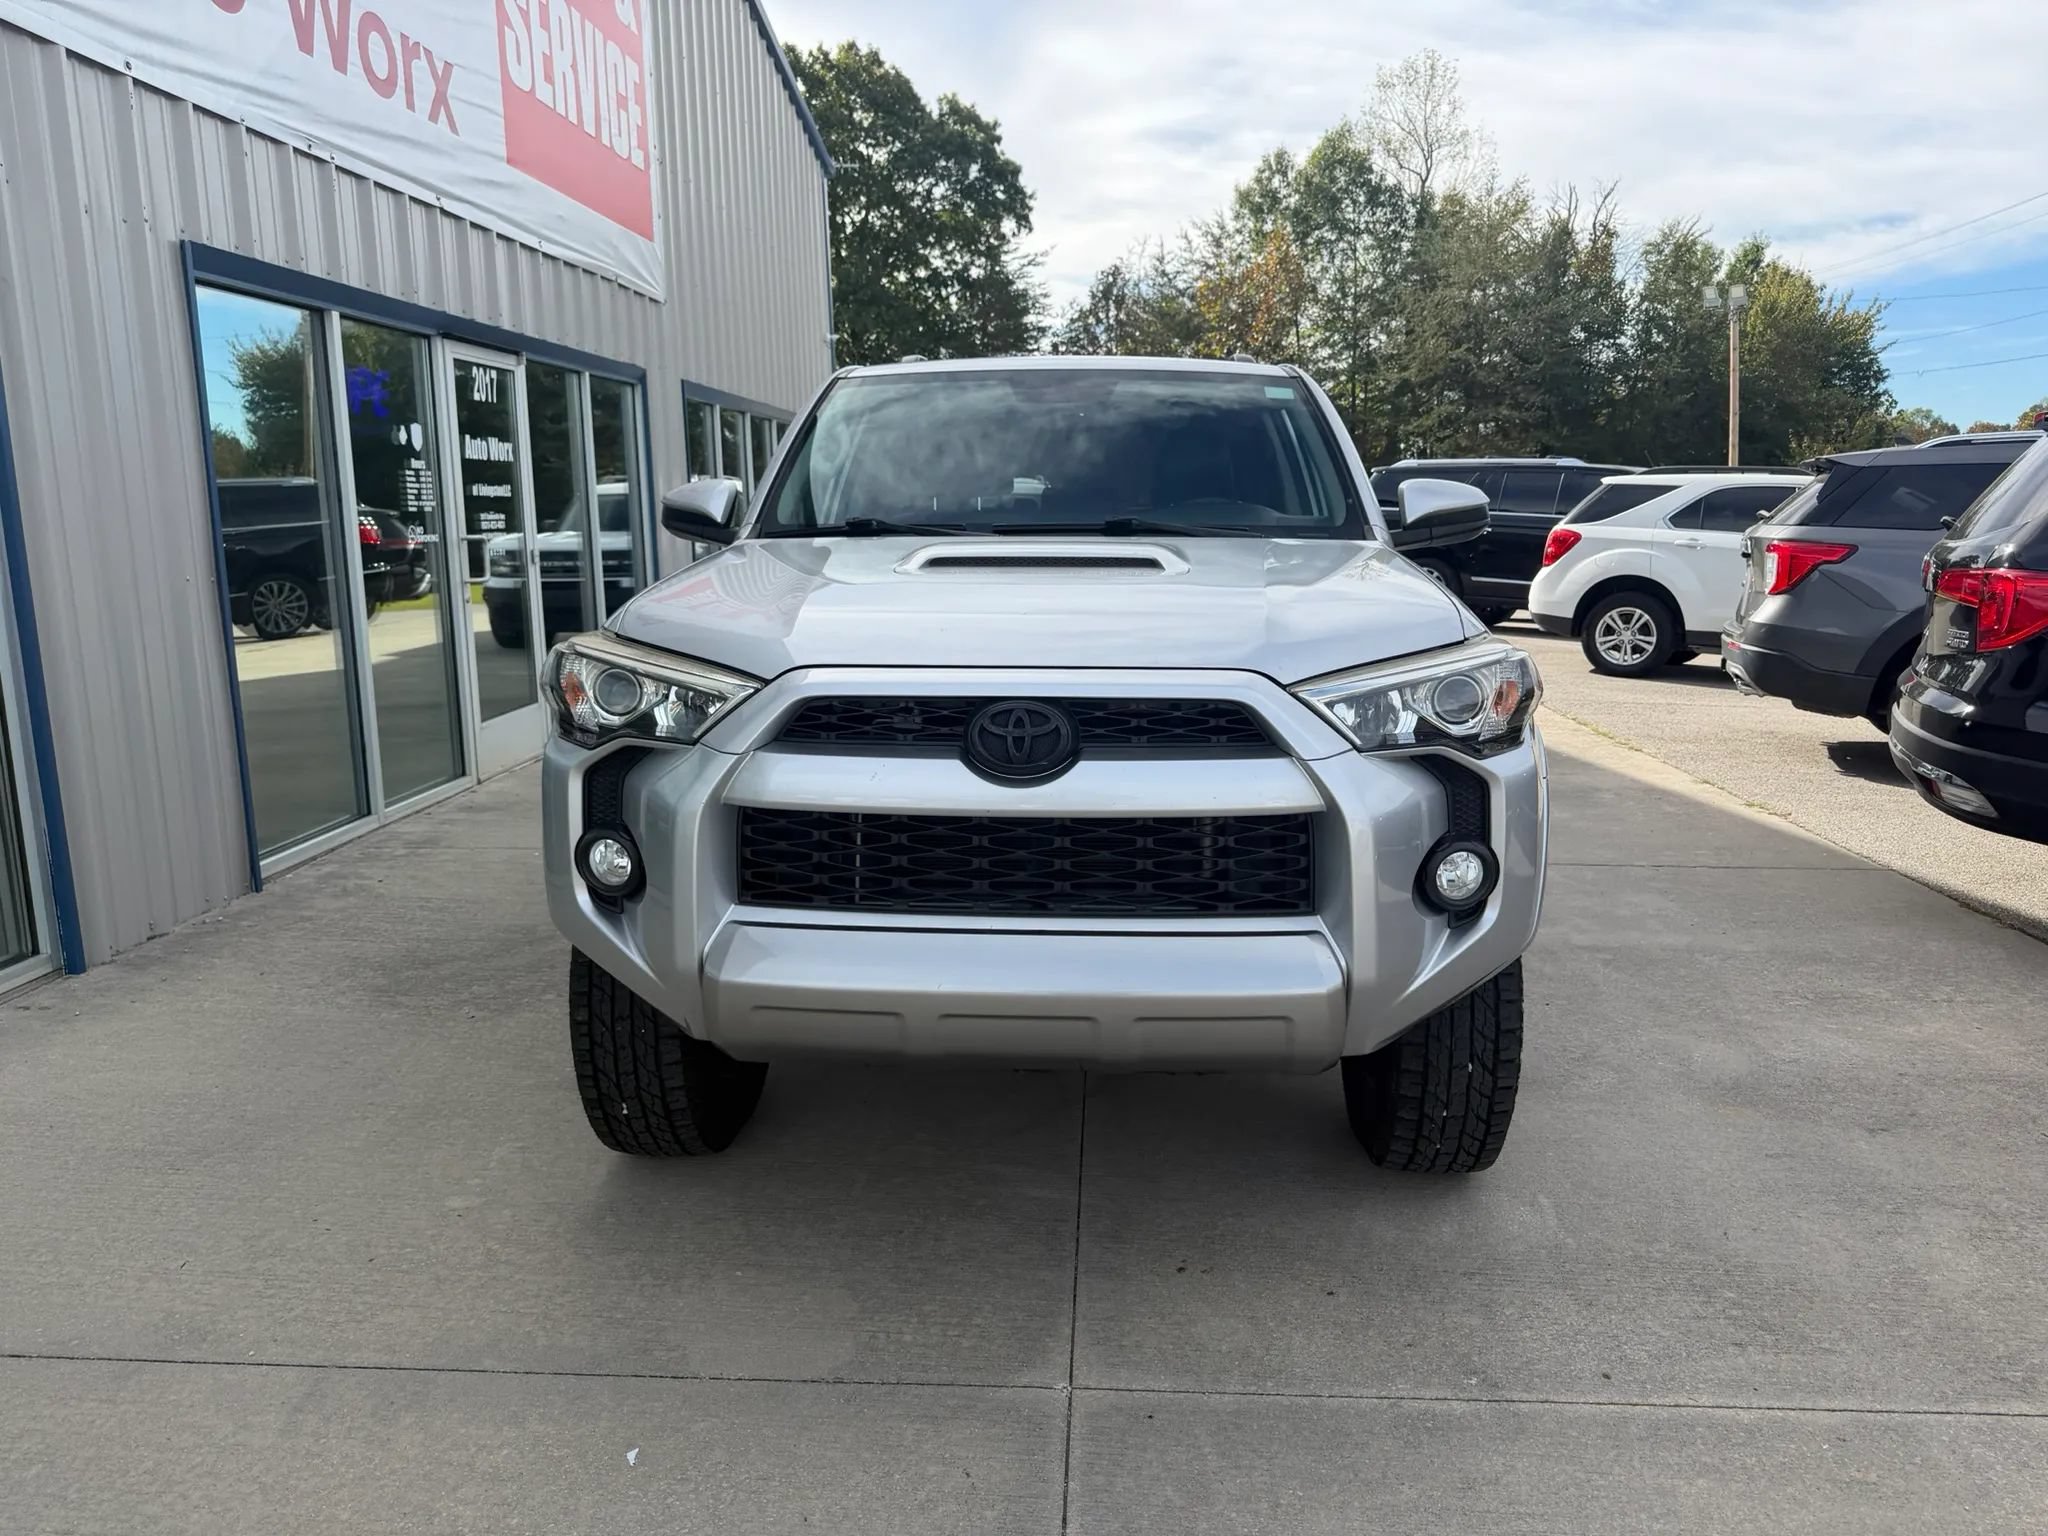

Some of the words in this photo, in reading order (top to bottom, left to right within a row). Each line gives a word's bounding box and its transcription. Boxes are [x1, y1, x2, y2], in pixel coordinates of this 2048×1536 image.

[288, 0, 460, 137] Worx
[503, 0, 645, 172] SERVICE
[472, 366, 497, 403] 2017
[465, 434, 488, 461] Auto
[488, 437, 514, 463] Worx
